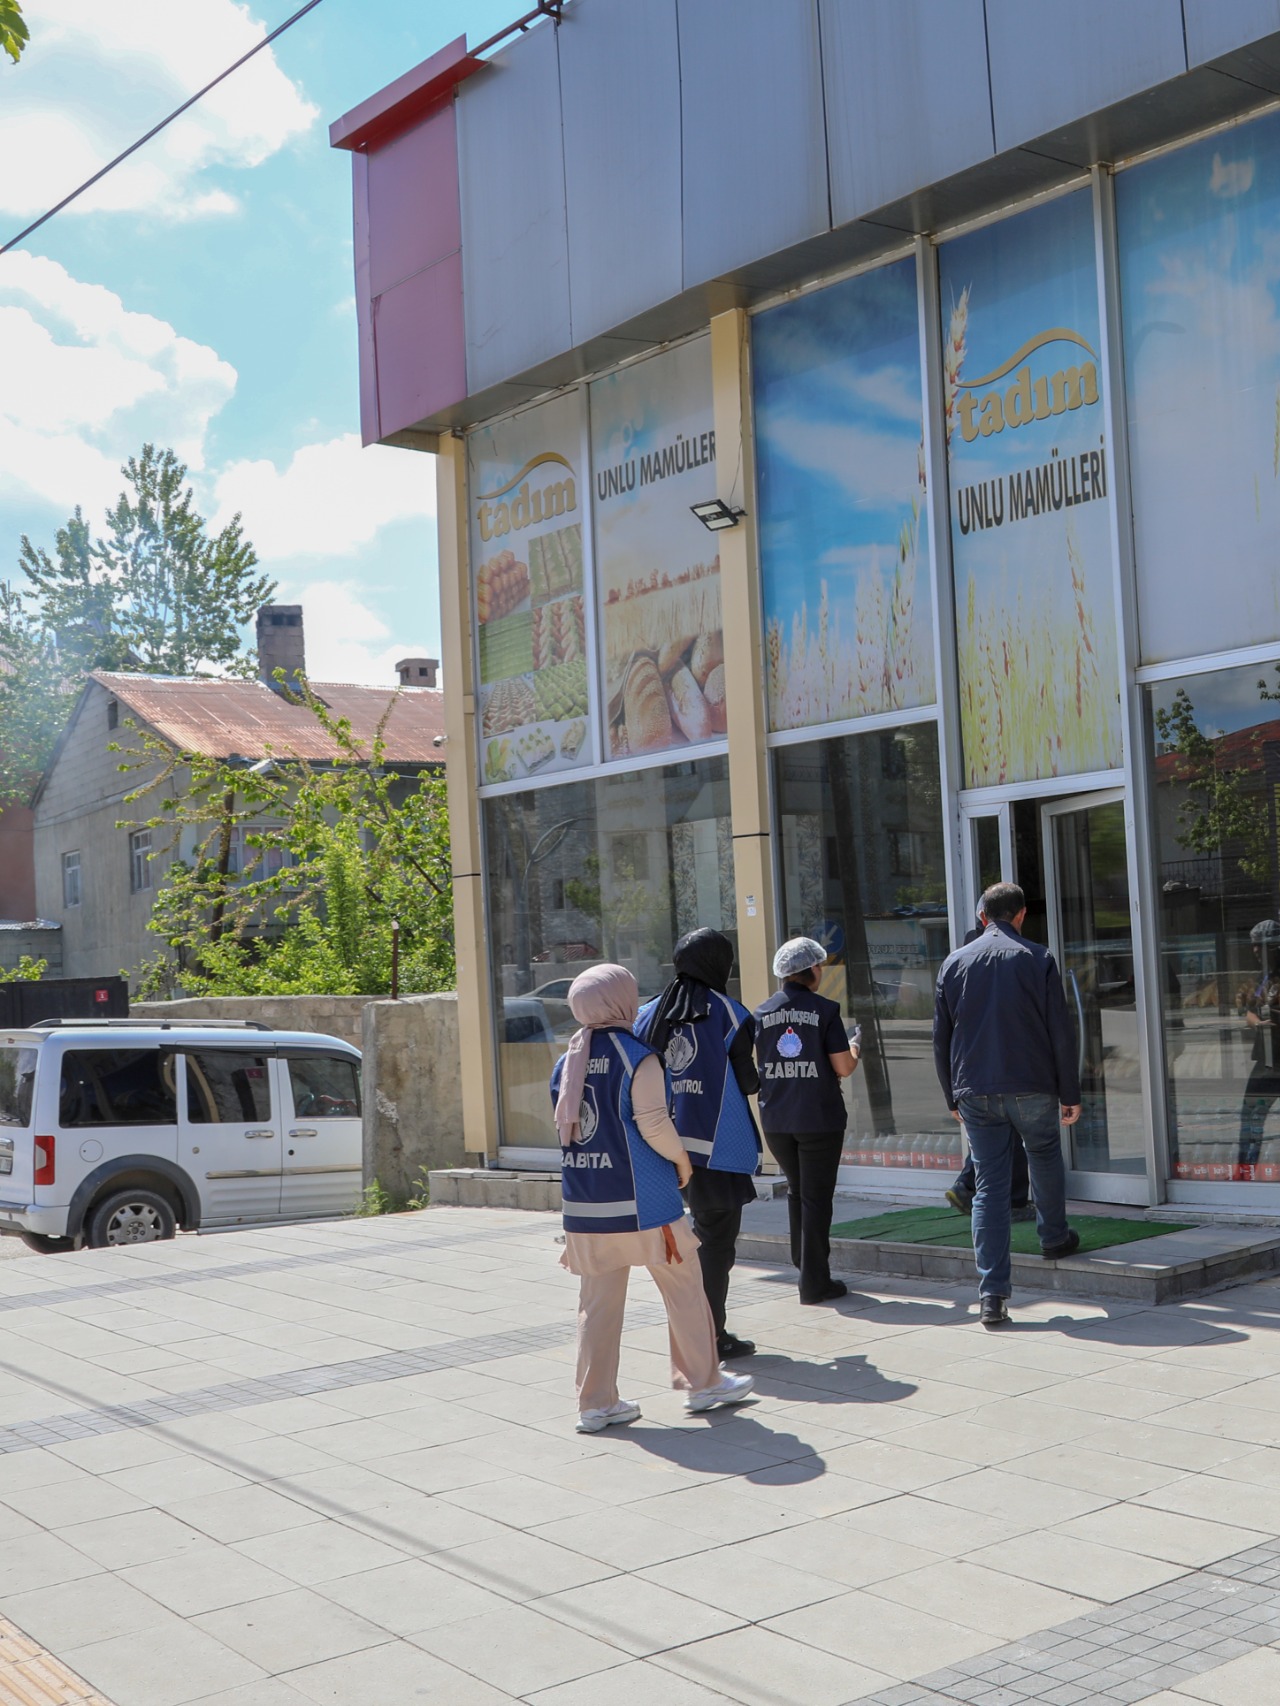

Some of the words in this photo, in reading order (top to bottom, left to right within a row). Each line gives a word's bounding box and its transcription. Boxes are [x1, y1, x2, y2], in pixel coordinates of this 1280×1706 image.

[957, 360, 1099, 442] tadım
[597, 459, 636, 501] UNLU
[640, 430, 716, 486] MAMÜLLER
[957, 477, 1004, 535] UNLU
[1009, 435, 1107, 522] MAMÜLLERİ
[477, 476, 577, 542] tadım
[764, 1061, 819, 1079] ZABITA
